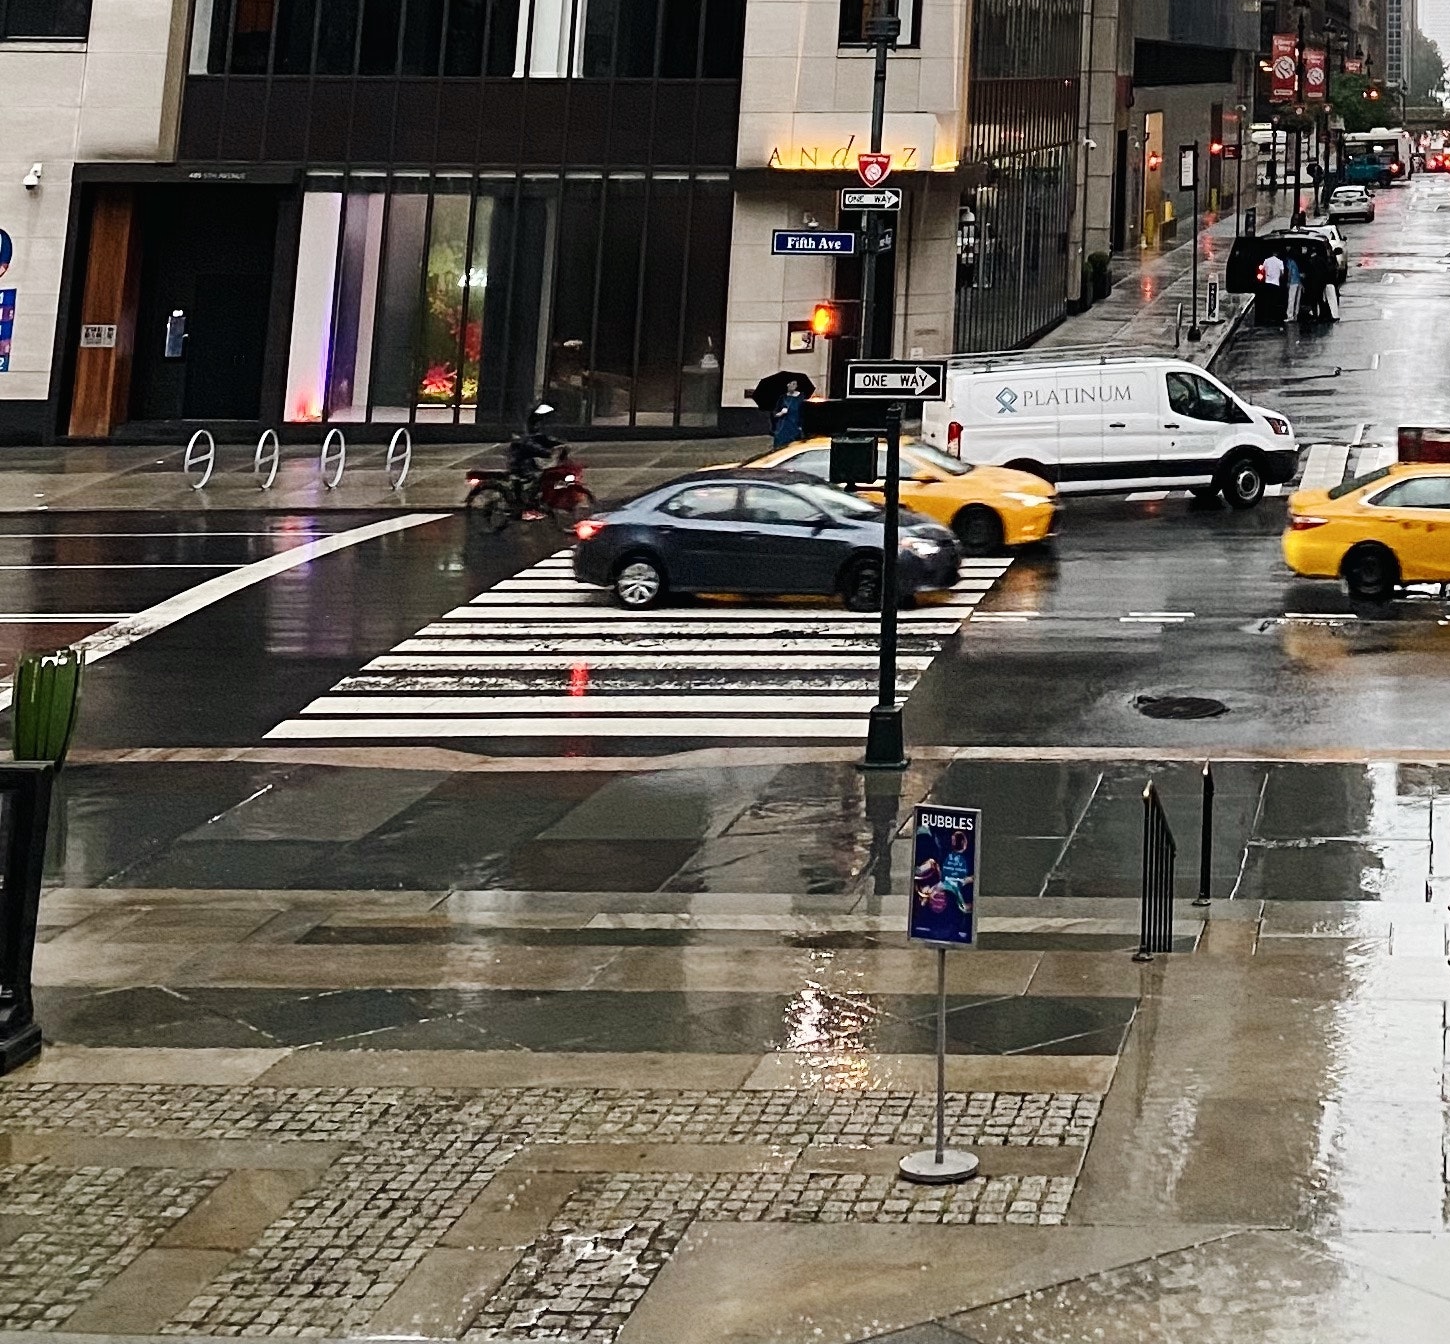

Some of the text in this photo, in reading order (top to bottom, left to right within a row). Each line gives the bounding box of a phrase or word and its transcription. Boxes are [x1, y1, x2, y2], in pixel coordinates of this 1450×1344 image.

[846, 194, 893, 204] ONE WAY
[786, 236, 842, 250] Fifth Ave
[862, 374, 929, 388] ONE WAY
[1023, 385, 1133, 407] PLATINUM
[921, 813, 974, 831] BUBBLES
